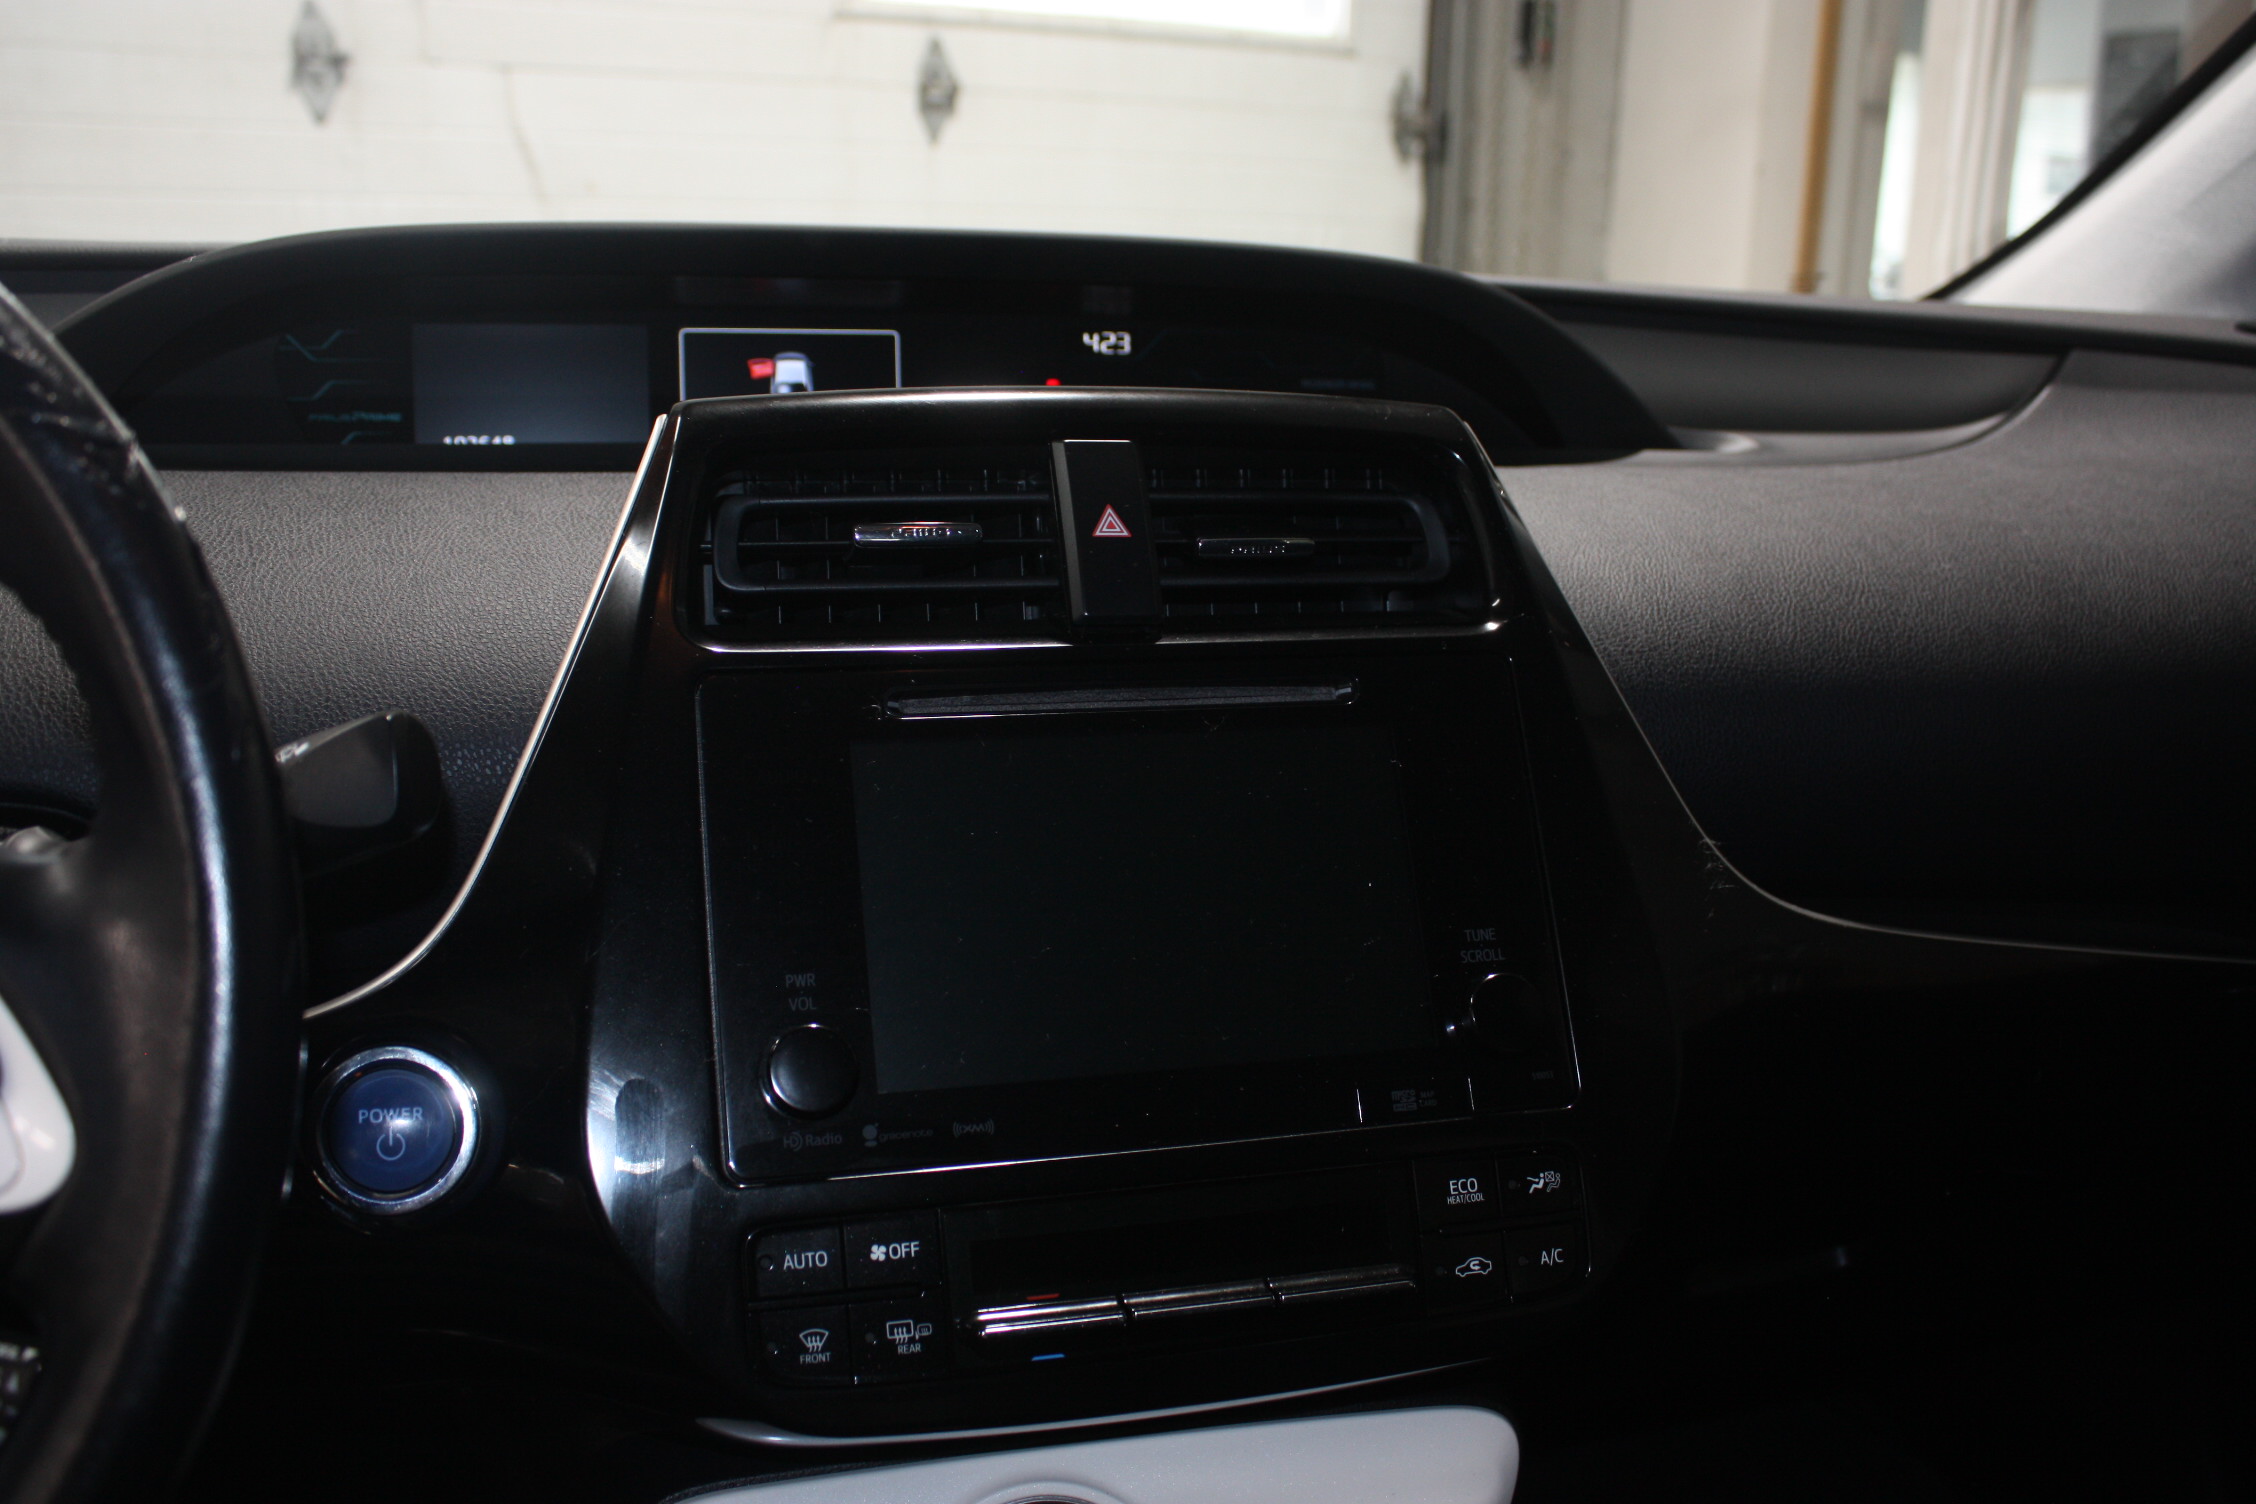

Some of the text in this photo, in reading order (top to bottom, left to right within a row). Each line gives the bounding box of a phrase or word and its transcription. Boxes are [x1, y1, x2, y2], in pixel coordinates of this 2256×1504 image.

[1464, 928, 1497, 943] TUNE
[1460, 948, 1507, 964] SCROLL
[785, 973, 816, 989] PWR
[788, 997, 818, 1012] VOL
[358, 1106, 424, 1124] POWER
[805, 1132, 843, 1147] Radio
[1449, 1177, 1478, 1195] ECO
[1447, 1192, 1486, 1205] HEAT/COOL
[888, 1241, 921, 1260] OFF
[1540, 1248, 1565, 1267] A/C
[783, 1250, 828, 1270] AUTO
[897, 1343, 922, 1356] REAR
[799, 1352, 832, 1365] FRONT
